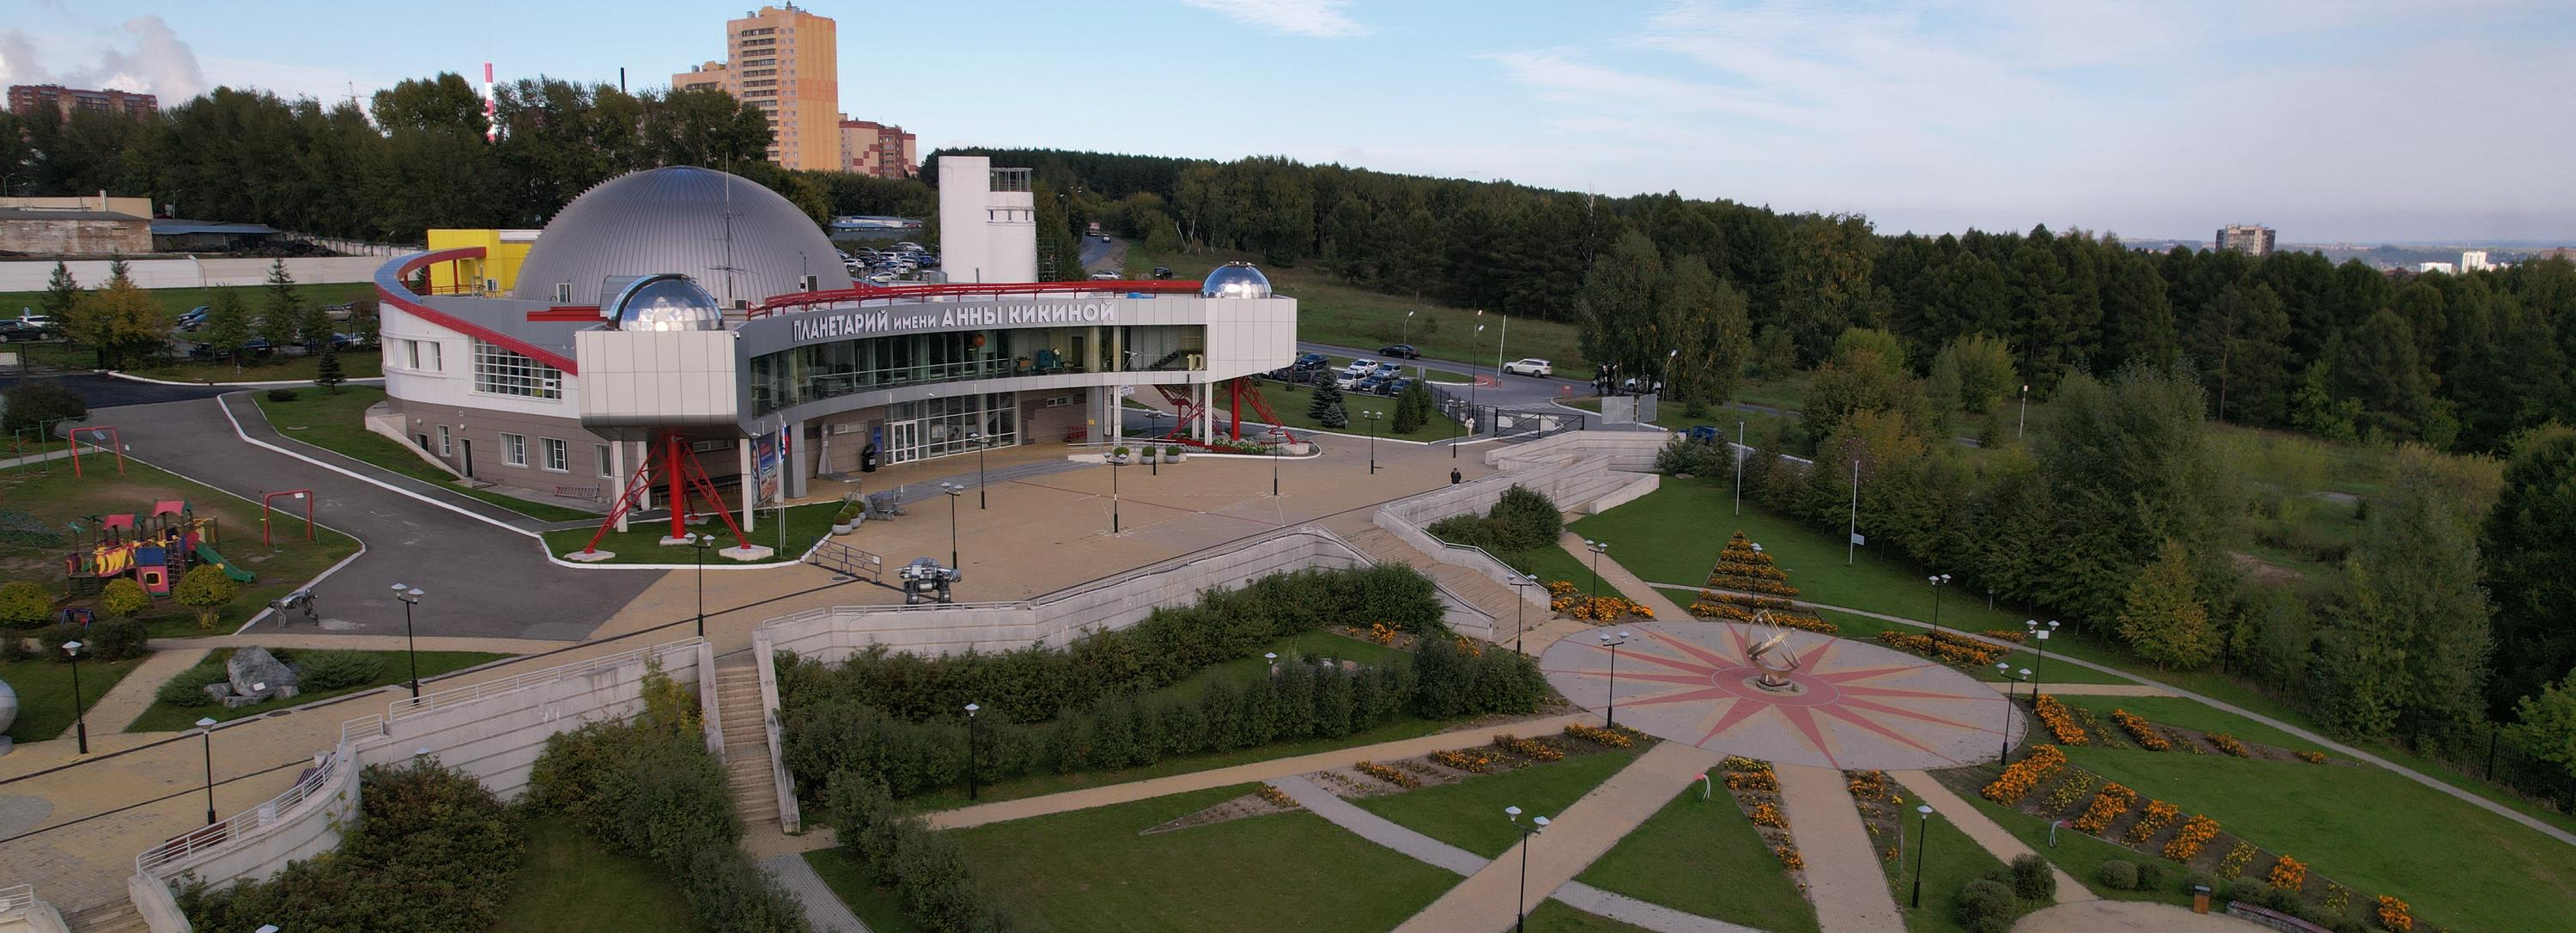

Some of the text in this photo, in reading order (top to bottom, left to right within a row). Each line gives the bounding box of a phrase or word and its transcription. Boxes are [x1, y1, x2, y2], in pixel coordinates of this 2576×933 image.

[793, 302, 1114, 342] ПЛАНЕТАРИЙ ИМЕНИ АННЫ КИКИНОЙ
